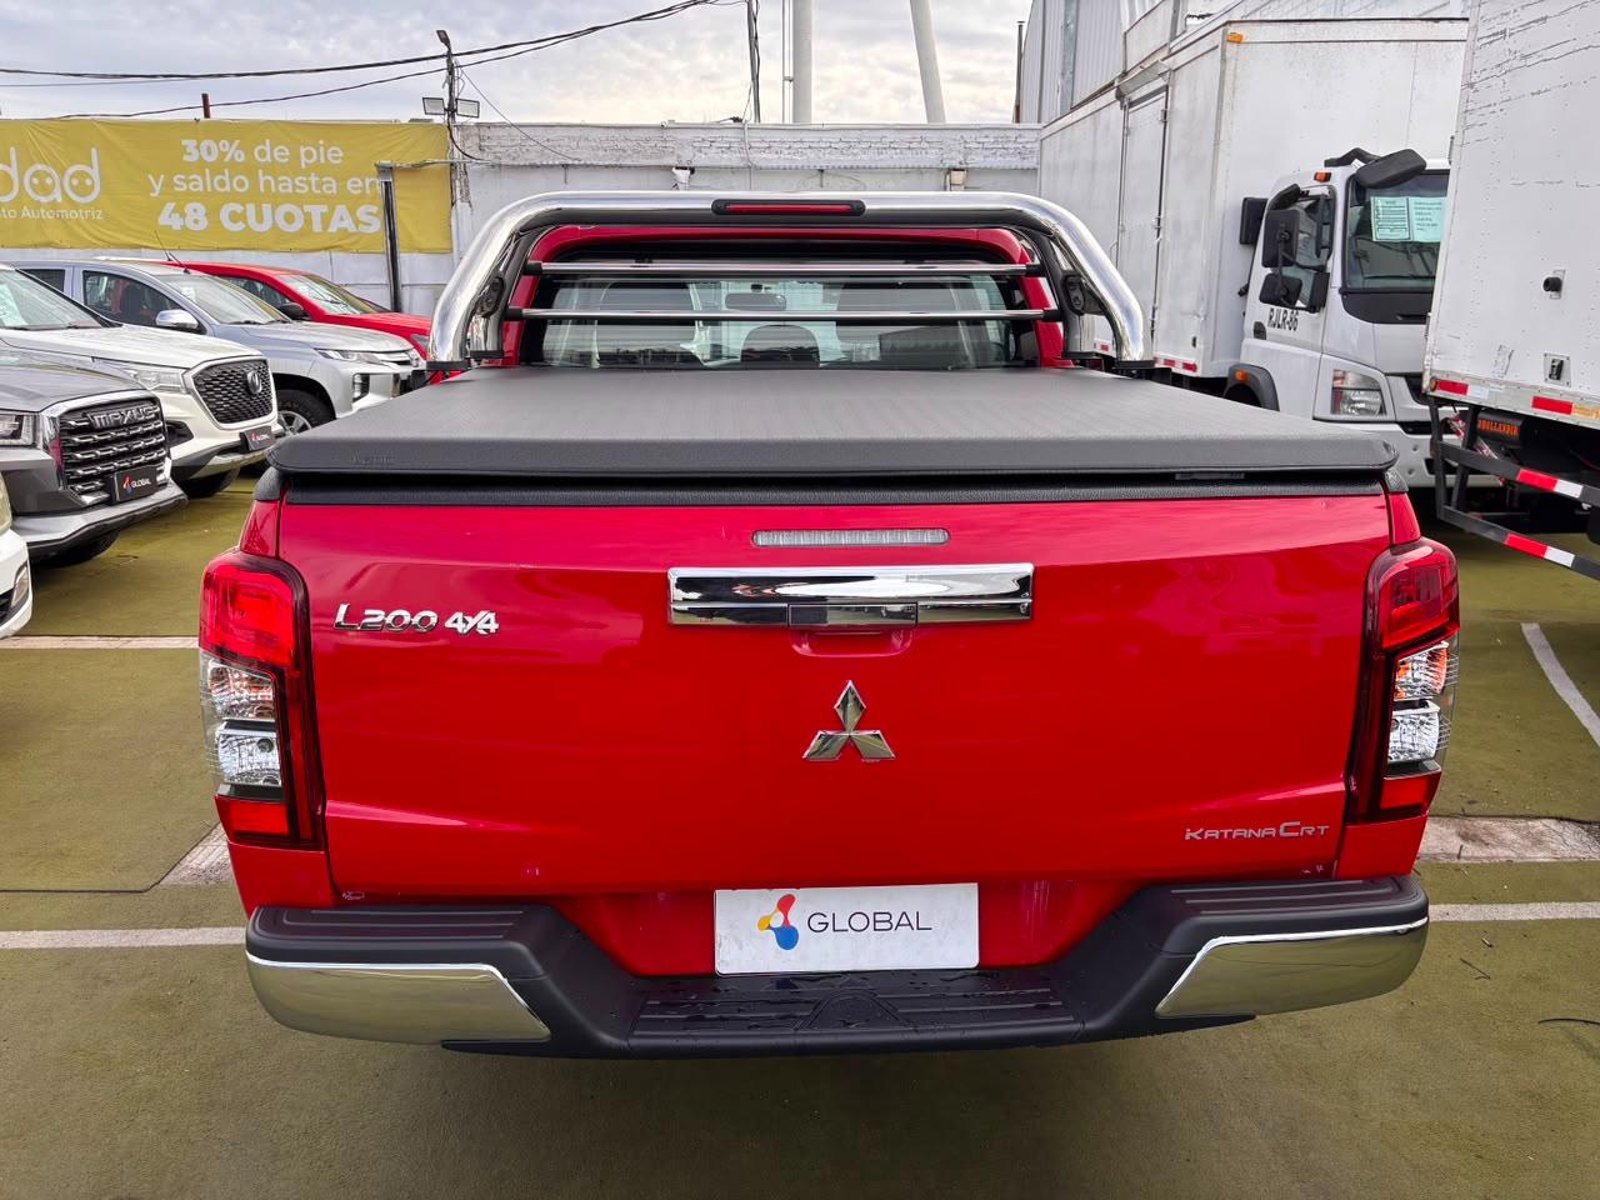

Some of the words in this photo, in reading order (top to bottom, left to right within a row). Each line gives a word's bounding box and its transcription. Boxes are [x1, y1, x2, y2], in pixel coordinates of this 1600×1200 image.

[181, 138, 245, 162] 30%
[253, 138, 290, 163] de
[299, 139, 344, 169] pie
[147, 173, 165, 197] y
[173, 168, 249, 193] saldo
[258, 168, 337, 195] hasta
[346, 175, 380, 195] en
[21, 205, 104, 220] Automotriz
[158, 202, 209, 231] 48
[219, 202, 381, 233] CUOTAS
[334, 602, 438, 632] L200
[807, 910, 933, 934] GLOBAL
